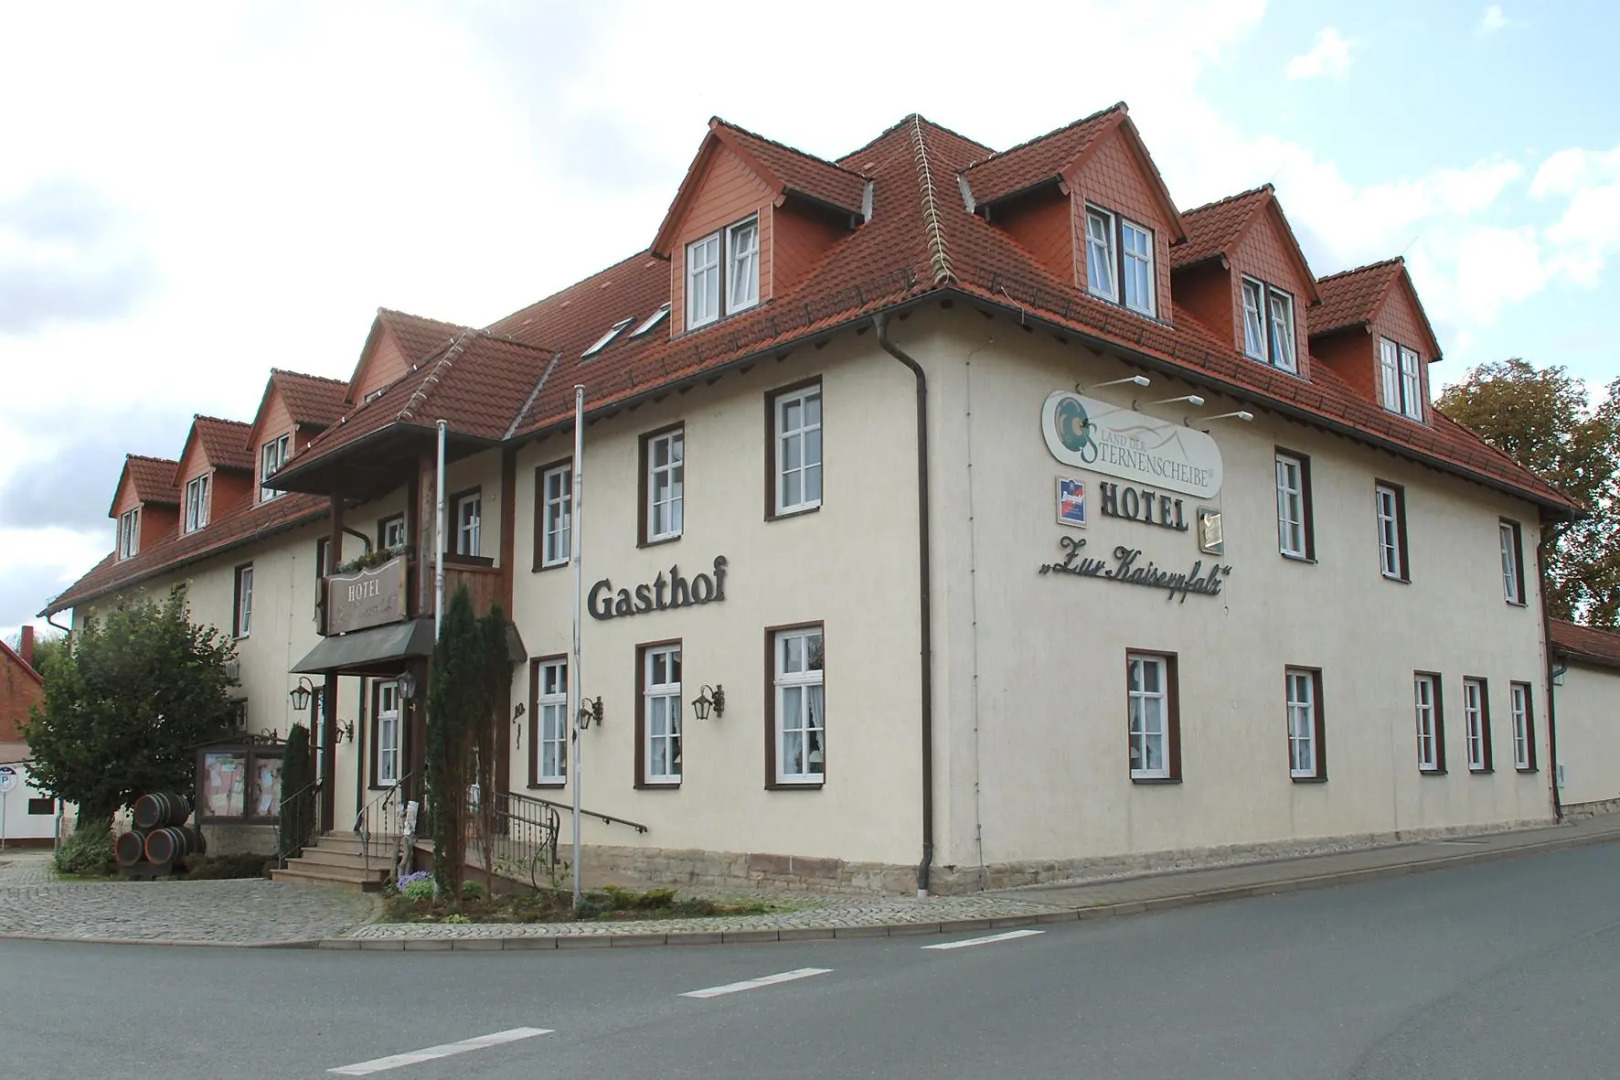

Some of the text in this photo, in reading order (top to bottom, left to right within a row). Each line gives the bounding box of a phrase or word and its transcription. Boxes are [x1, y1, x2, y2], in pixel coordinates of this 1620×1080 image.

[1101, 429, 1147, 453] LAND DER
[1100, 481, 1189, 532] HOTEL
[348, 579, 379, 602] HOTEL
[587, 555, 727, 621] Gasthof
[1, 775, 9, 784] P
